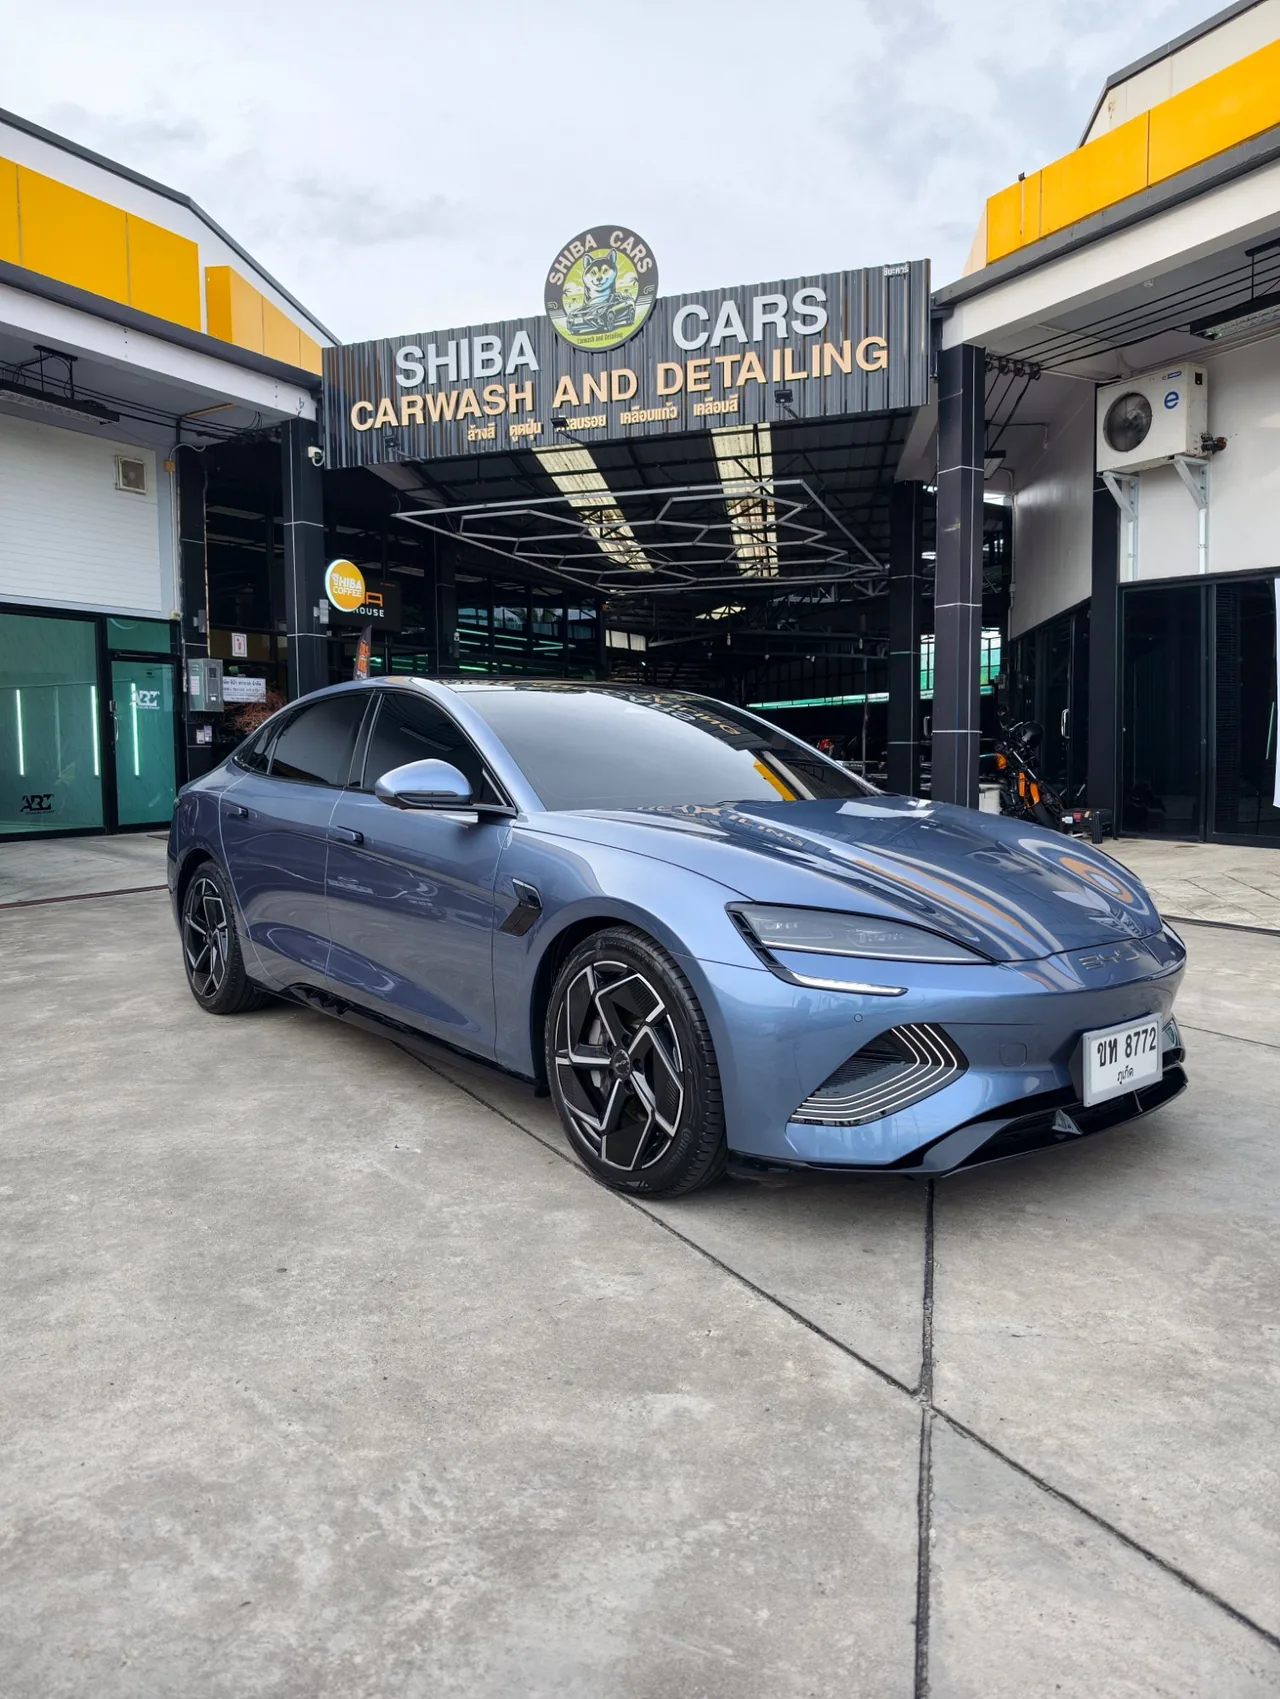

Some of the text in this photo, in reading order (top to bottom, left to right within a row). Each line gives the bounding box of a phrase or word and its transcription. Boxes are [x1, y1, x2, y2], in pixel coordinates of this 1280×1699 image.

[549, 231, 653, 285] SHIBA CARS
[395, 287, 828, 388] SHIBA CARS
[351, 336, 888, 431] CARWASH AND DETAILING
[333, 586, 362, 598] COFFEE
[1125, 1026, 1157, 1058] 8772
